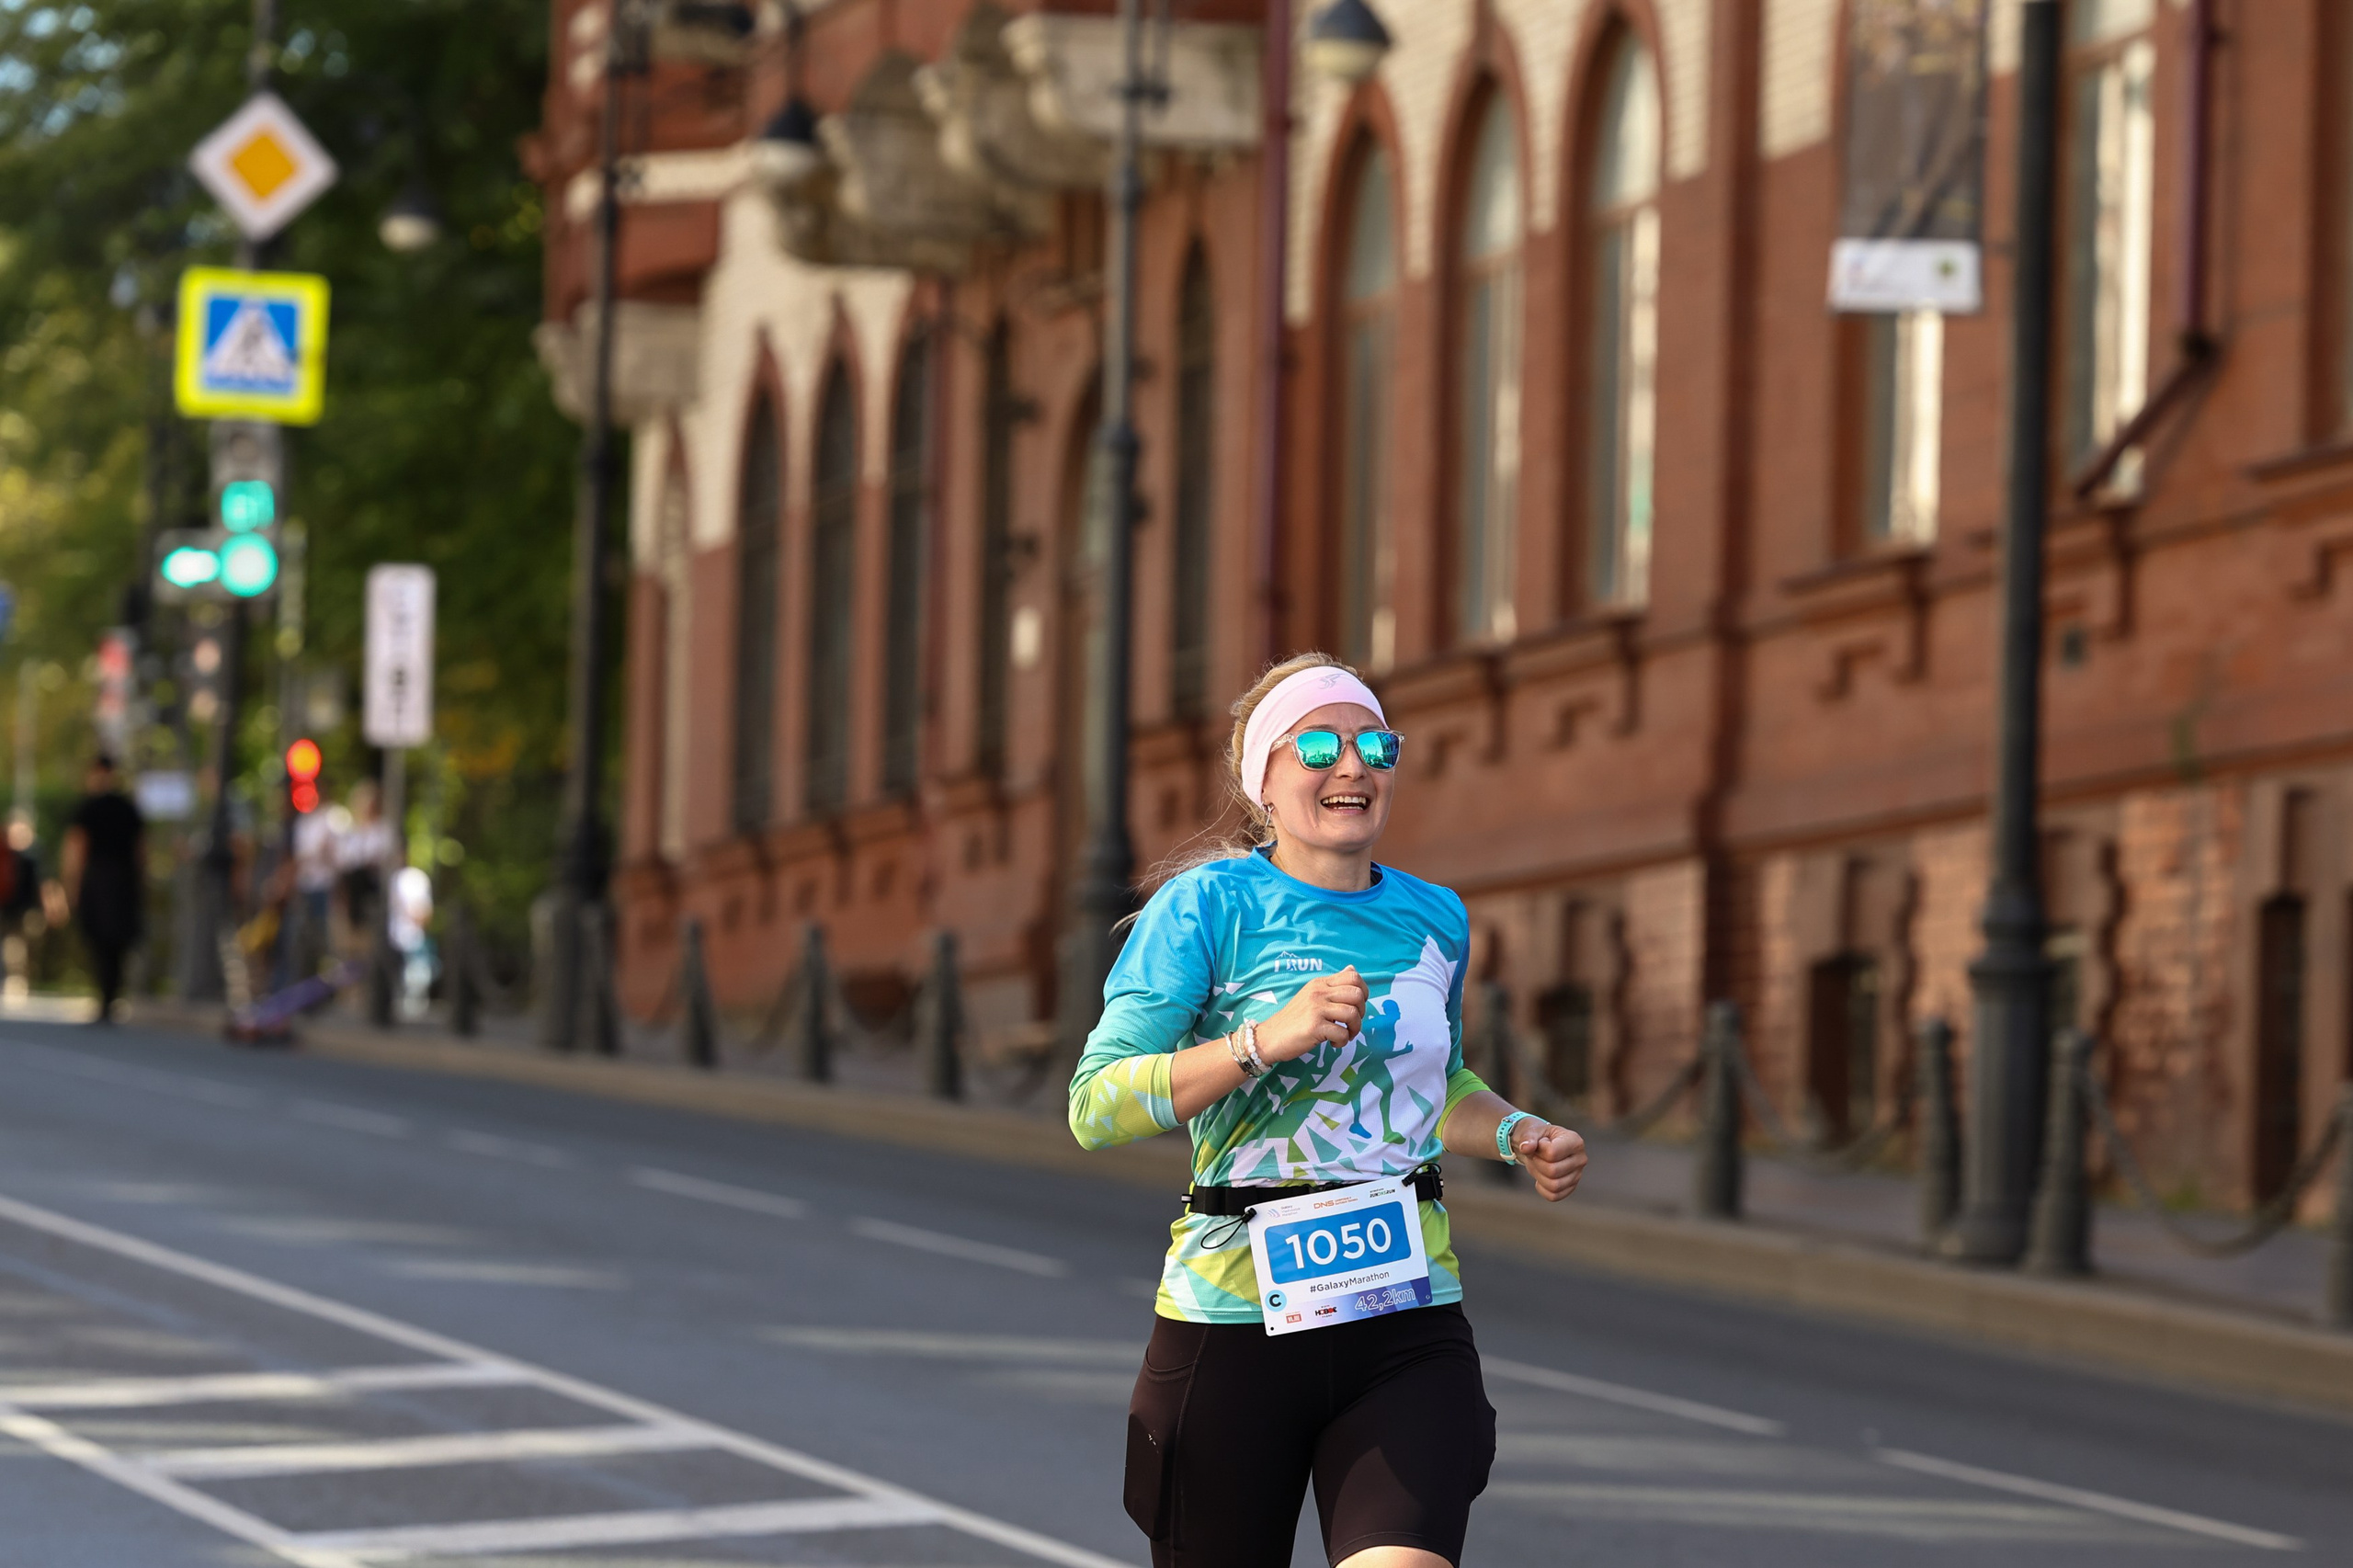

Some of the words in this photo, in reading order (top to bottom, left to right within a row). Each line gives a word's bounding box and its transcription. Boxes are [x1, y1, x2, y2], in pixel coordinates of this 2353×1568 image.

[1286, 959, 1323, 971] RUN
[1313, 1199, 1335, 1210] DNS
[1285, 1217, 1392, 1269] 1050
[1310, 1270, 1390, 1293] #GalaxyMarathon
[1355, 1288, 1415, 1312] 42,2km
